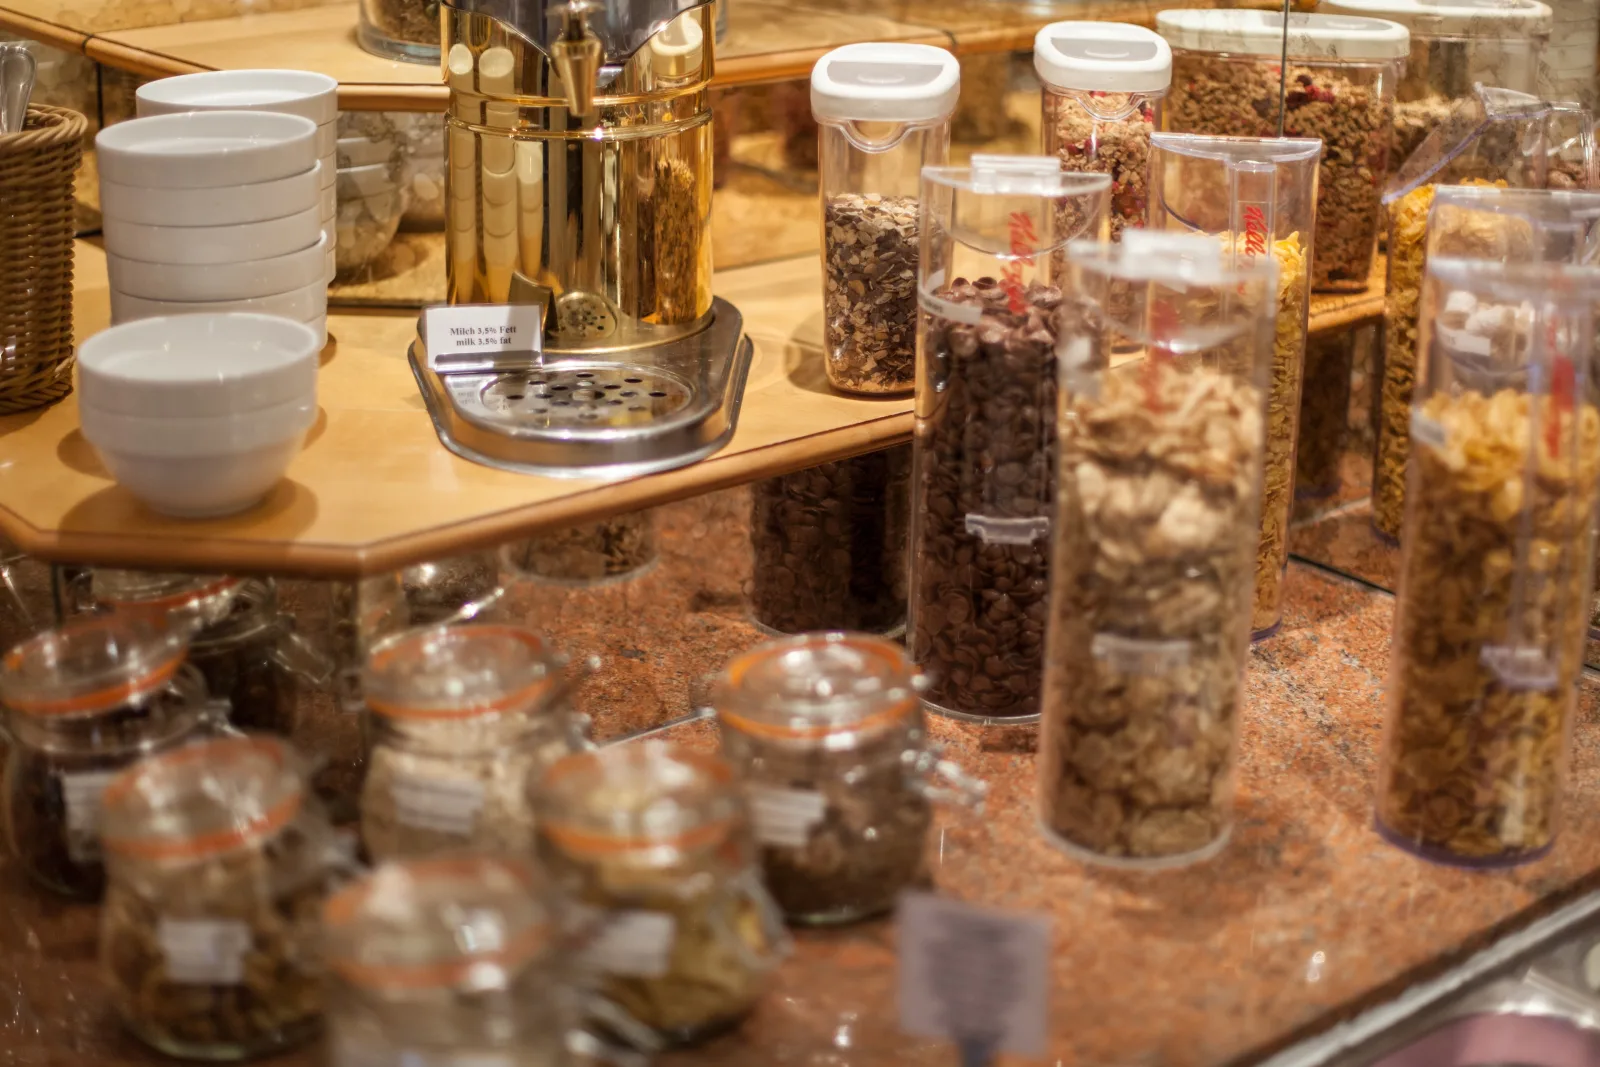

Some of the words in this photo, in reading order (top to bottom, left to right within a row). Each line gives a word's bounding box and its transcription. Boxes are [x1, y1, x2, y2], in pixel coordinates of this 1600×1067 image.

[450, 327, 475, 336] Milch
[499, 326, 517, 334] Fett
[456, 338, 476, 346] milk
[500, 336, 512, 345] fat
